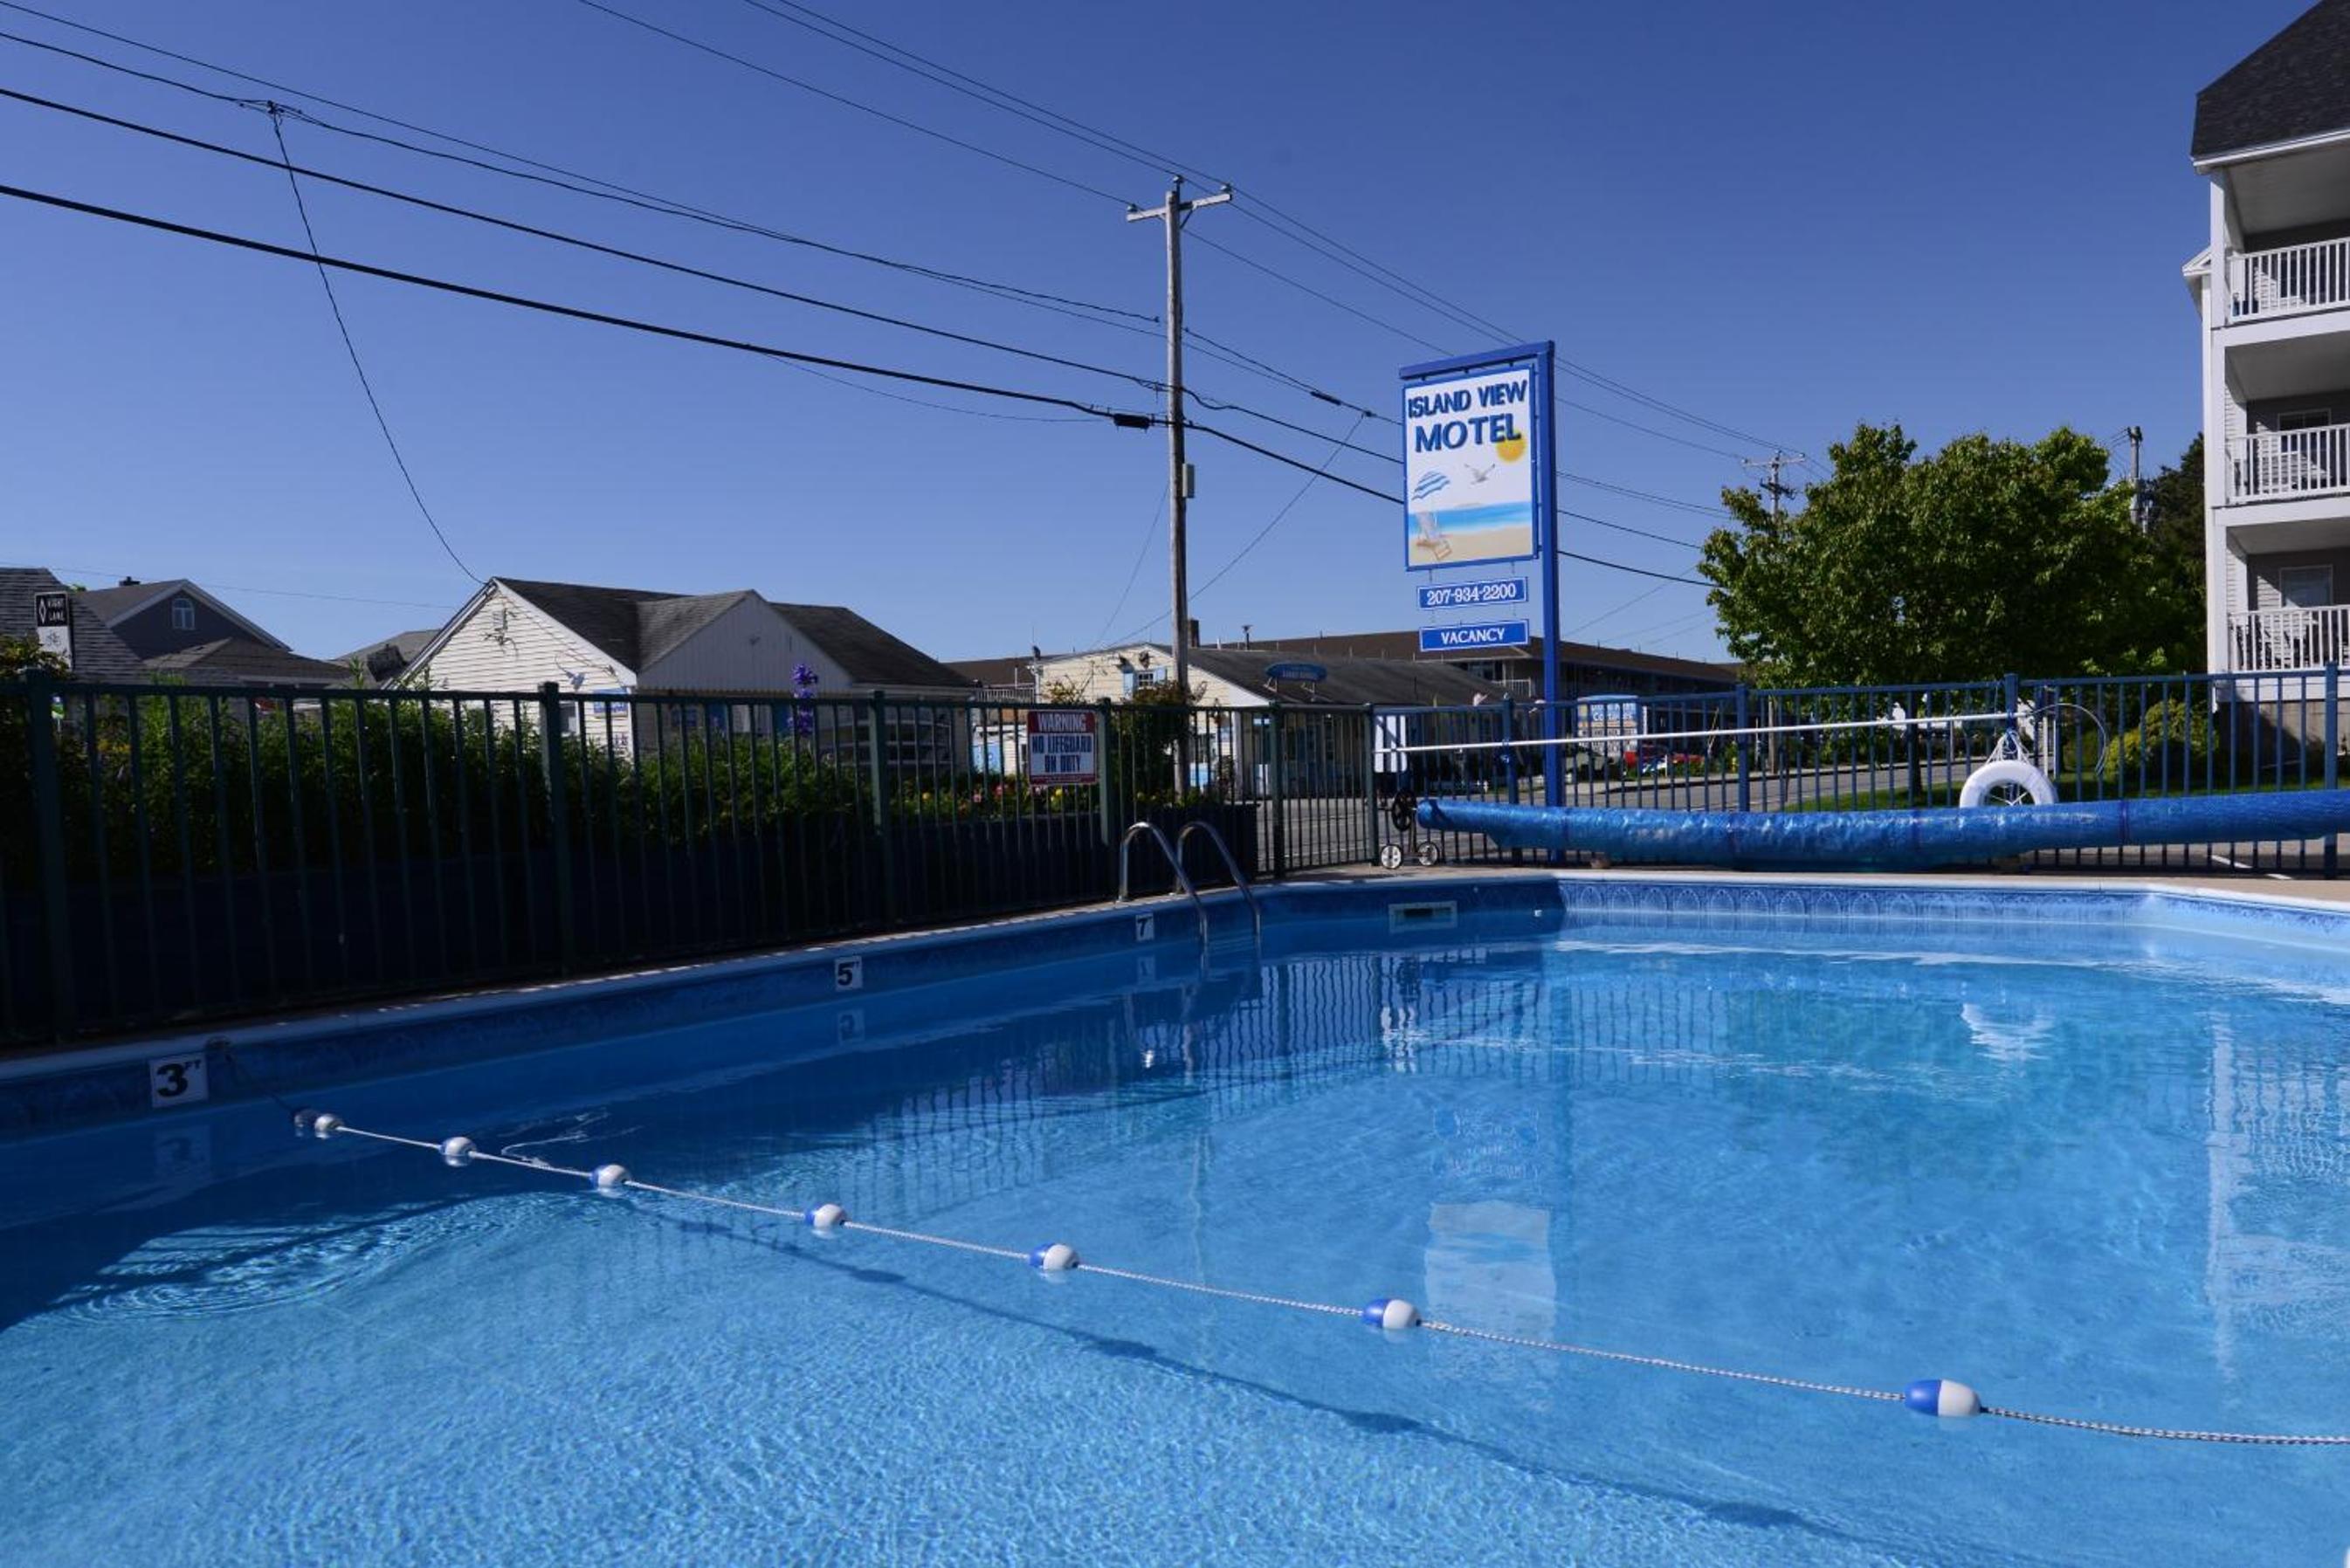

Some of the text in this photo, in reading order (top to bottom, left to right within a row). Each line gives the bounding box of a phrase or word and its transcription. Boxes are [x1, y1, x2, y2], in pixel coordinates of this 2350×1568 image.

[1408, 380, 1527, 418] ISLAND VIEW
[1416, 413, 1522, 452] MOTEL
[1426, 582, 1517, 606] 207-934-2200
[1441, 628, 1506, 645] VACANCY
[1037, 712, 1087, 732] WARNING
[1032, 735, 1092, 753] NO LIFEGUARD
[1044, 754, 1081, 773] ON DUTY
[1137, 918, 1148, 938] 7
[838, 962, 853, 987] 5
[156, 1063, 189, 1098] 3
